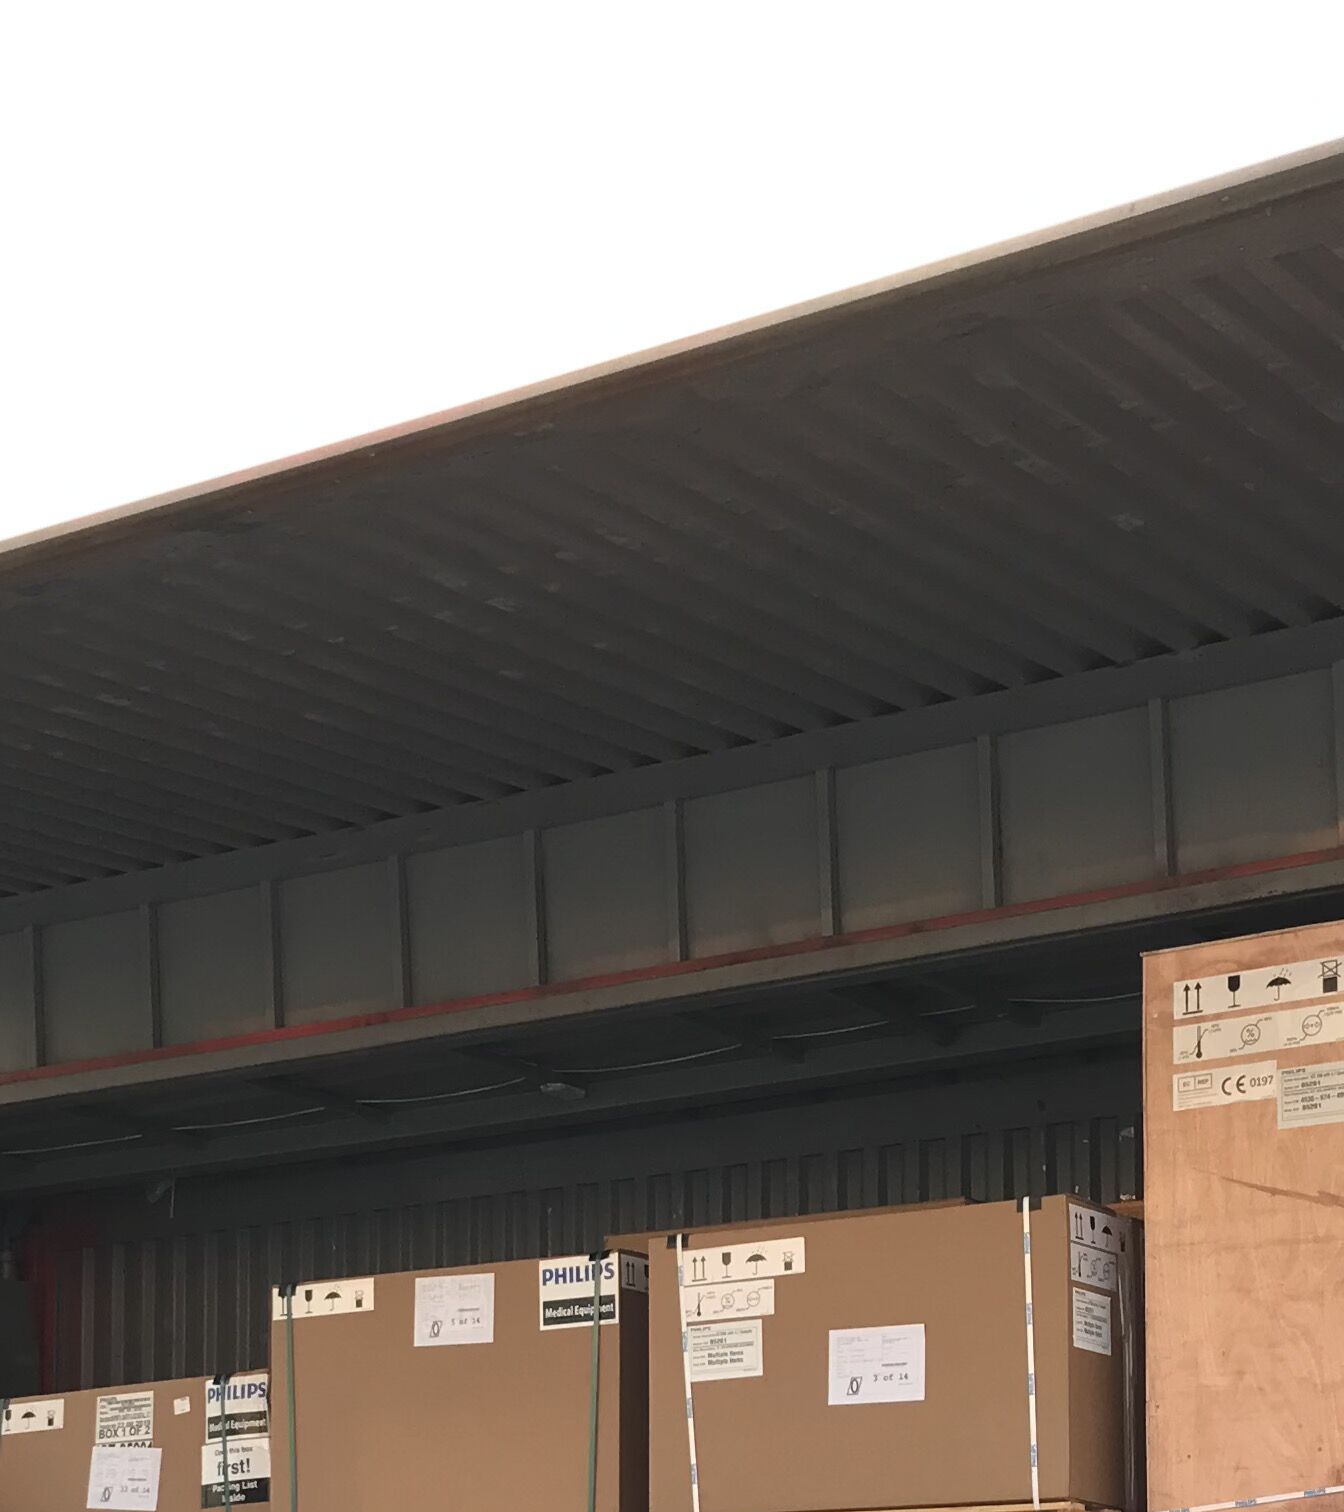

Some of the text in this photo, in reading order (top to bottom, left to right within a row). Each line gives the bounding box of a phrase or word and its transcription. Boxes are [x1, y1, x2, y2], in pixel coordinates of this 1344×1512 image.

[1249, 1075, 1274, 1088] 0197
[545, 1305, 574, 1318] Medical
[883, 1373, 894, 1381] of
[99, 1429, 119, 1440] BOX
[129, 1426, 142, 1436] OF
[145, 1425, 151, 1435] 2
[241, 1480, 258, 1490] List
